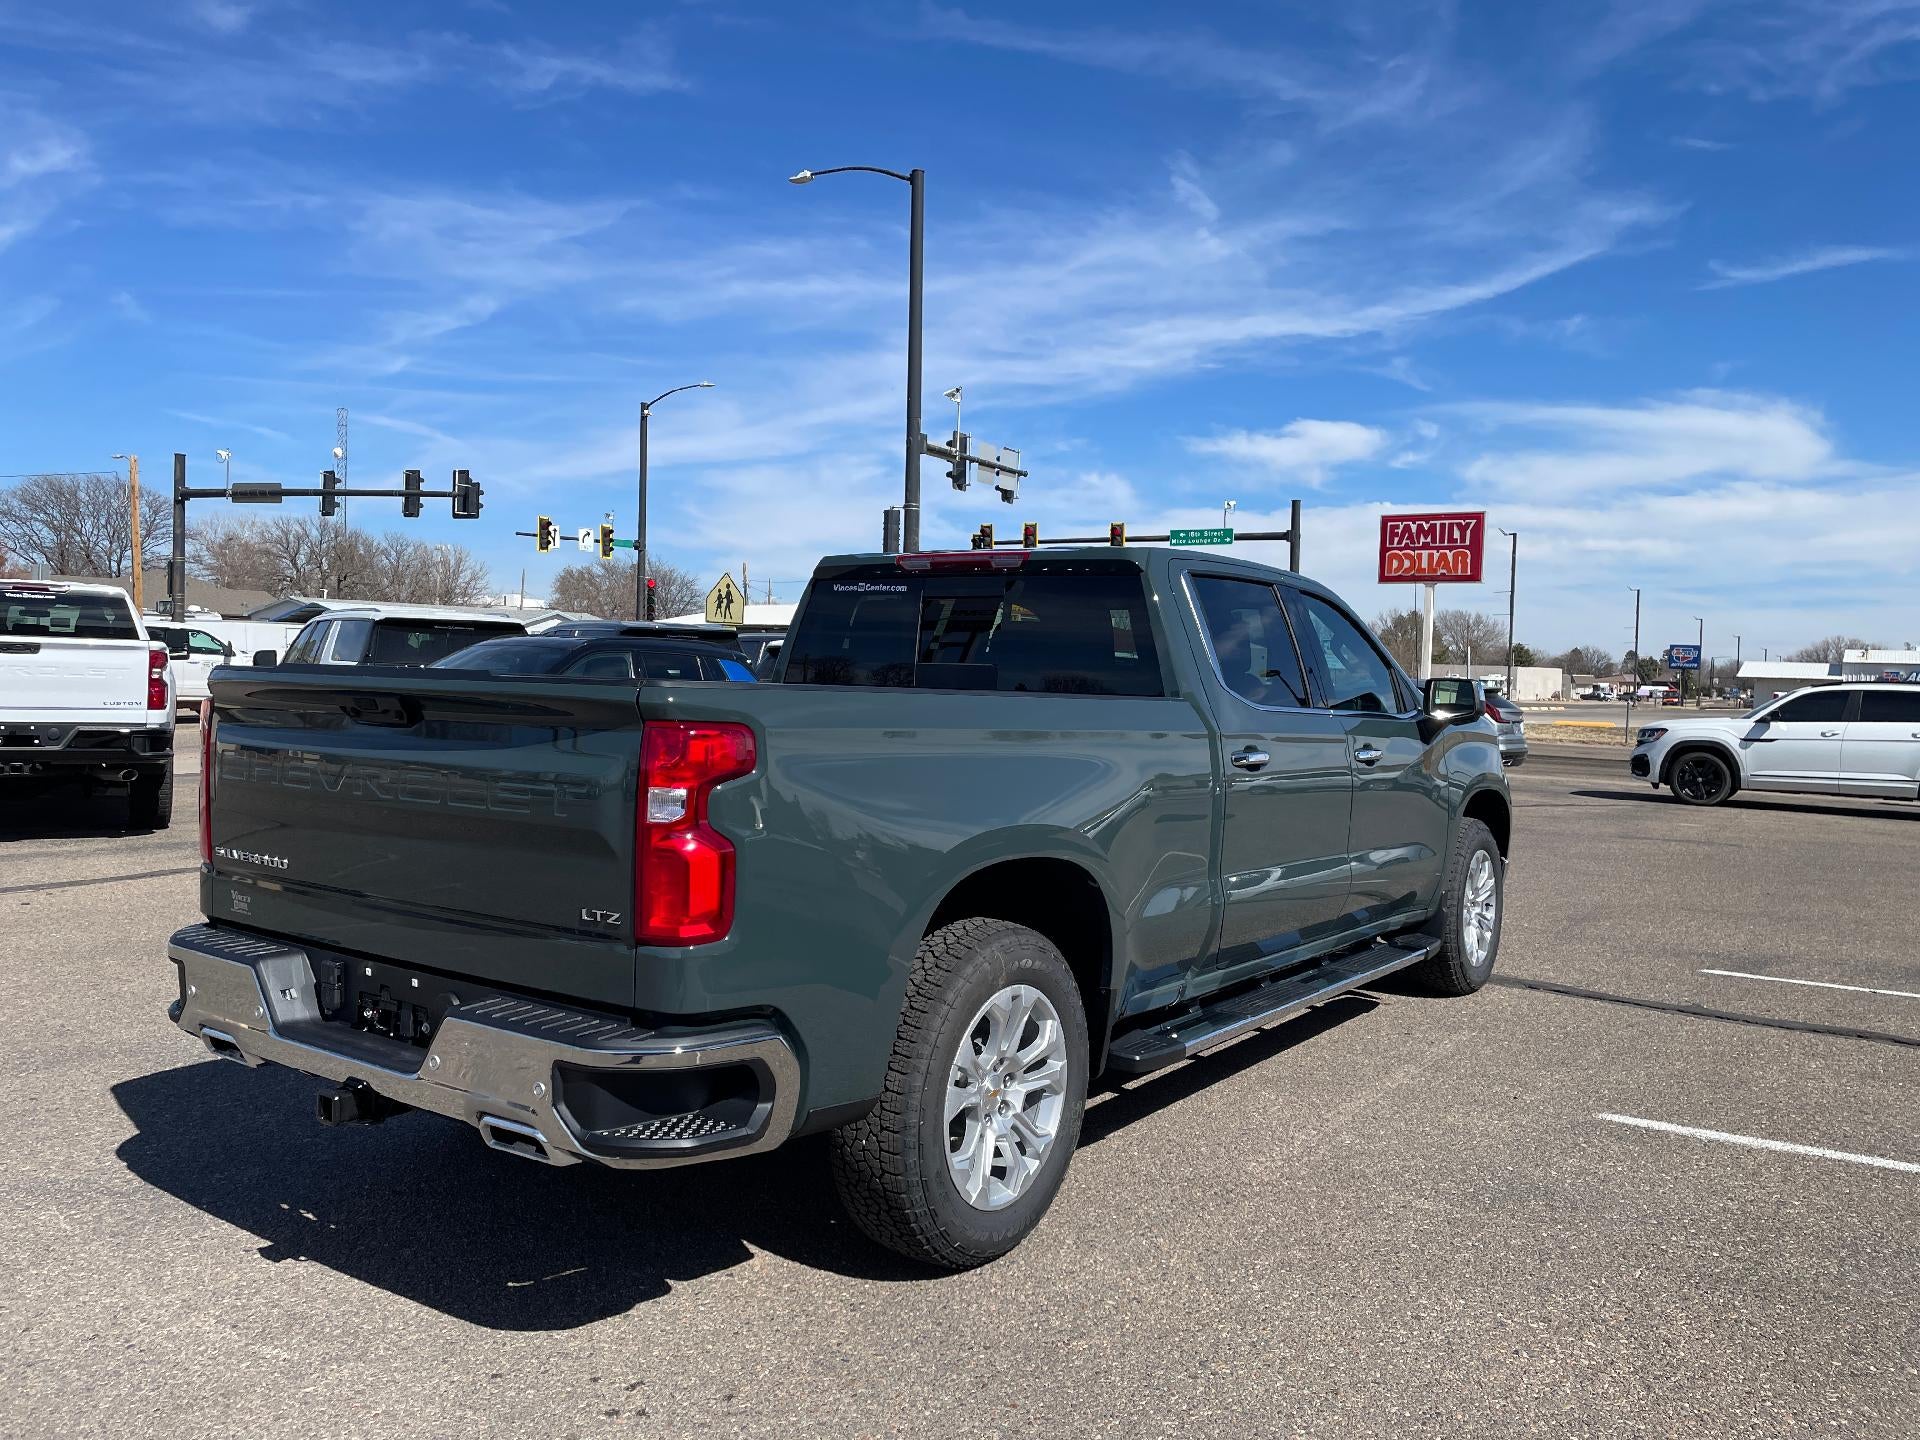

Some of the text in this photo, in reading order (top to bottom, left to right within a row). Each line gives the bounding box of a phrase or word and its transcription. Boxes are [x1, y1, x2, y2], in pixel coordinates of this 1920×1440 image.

[1387, 520, 1477, 547] FAMILY
[1385, 549, 1471, 576] DOLLAR
[833, 583, 907, 592] VincesCenter.com
[581, 908, 621, 925] LTZ
